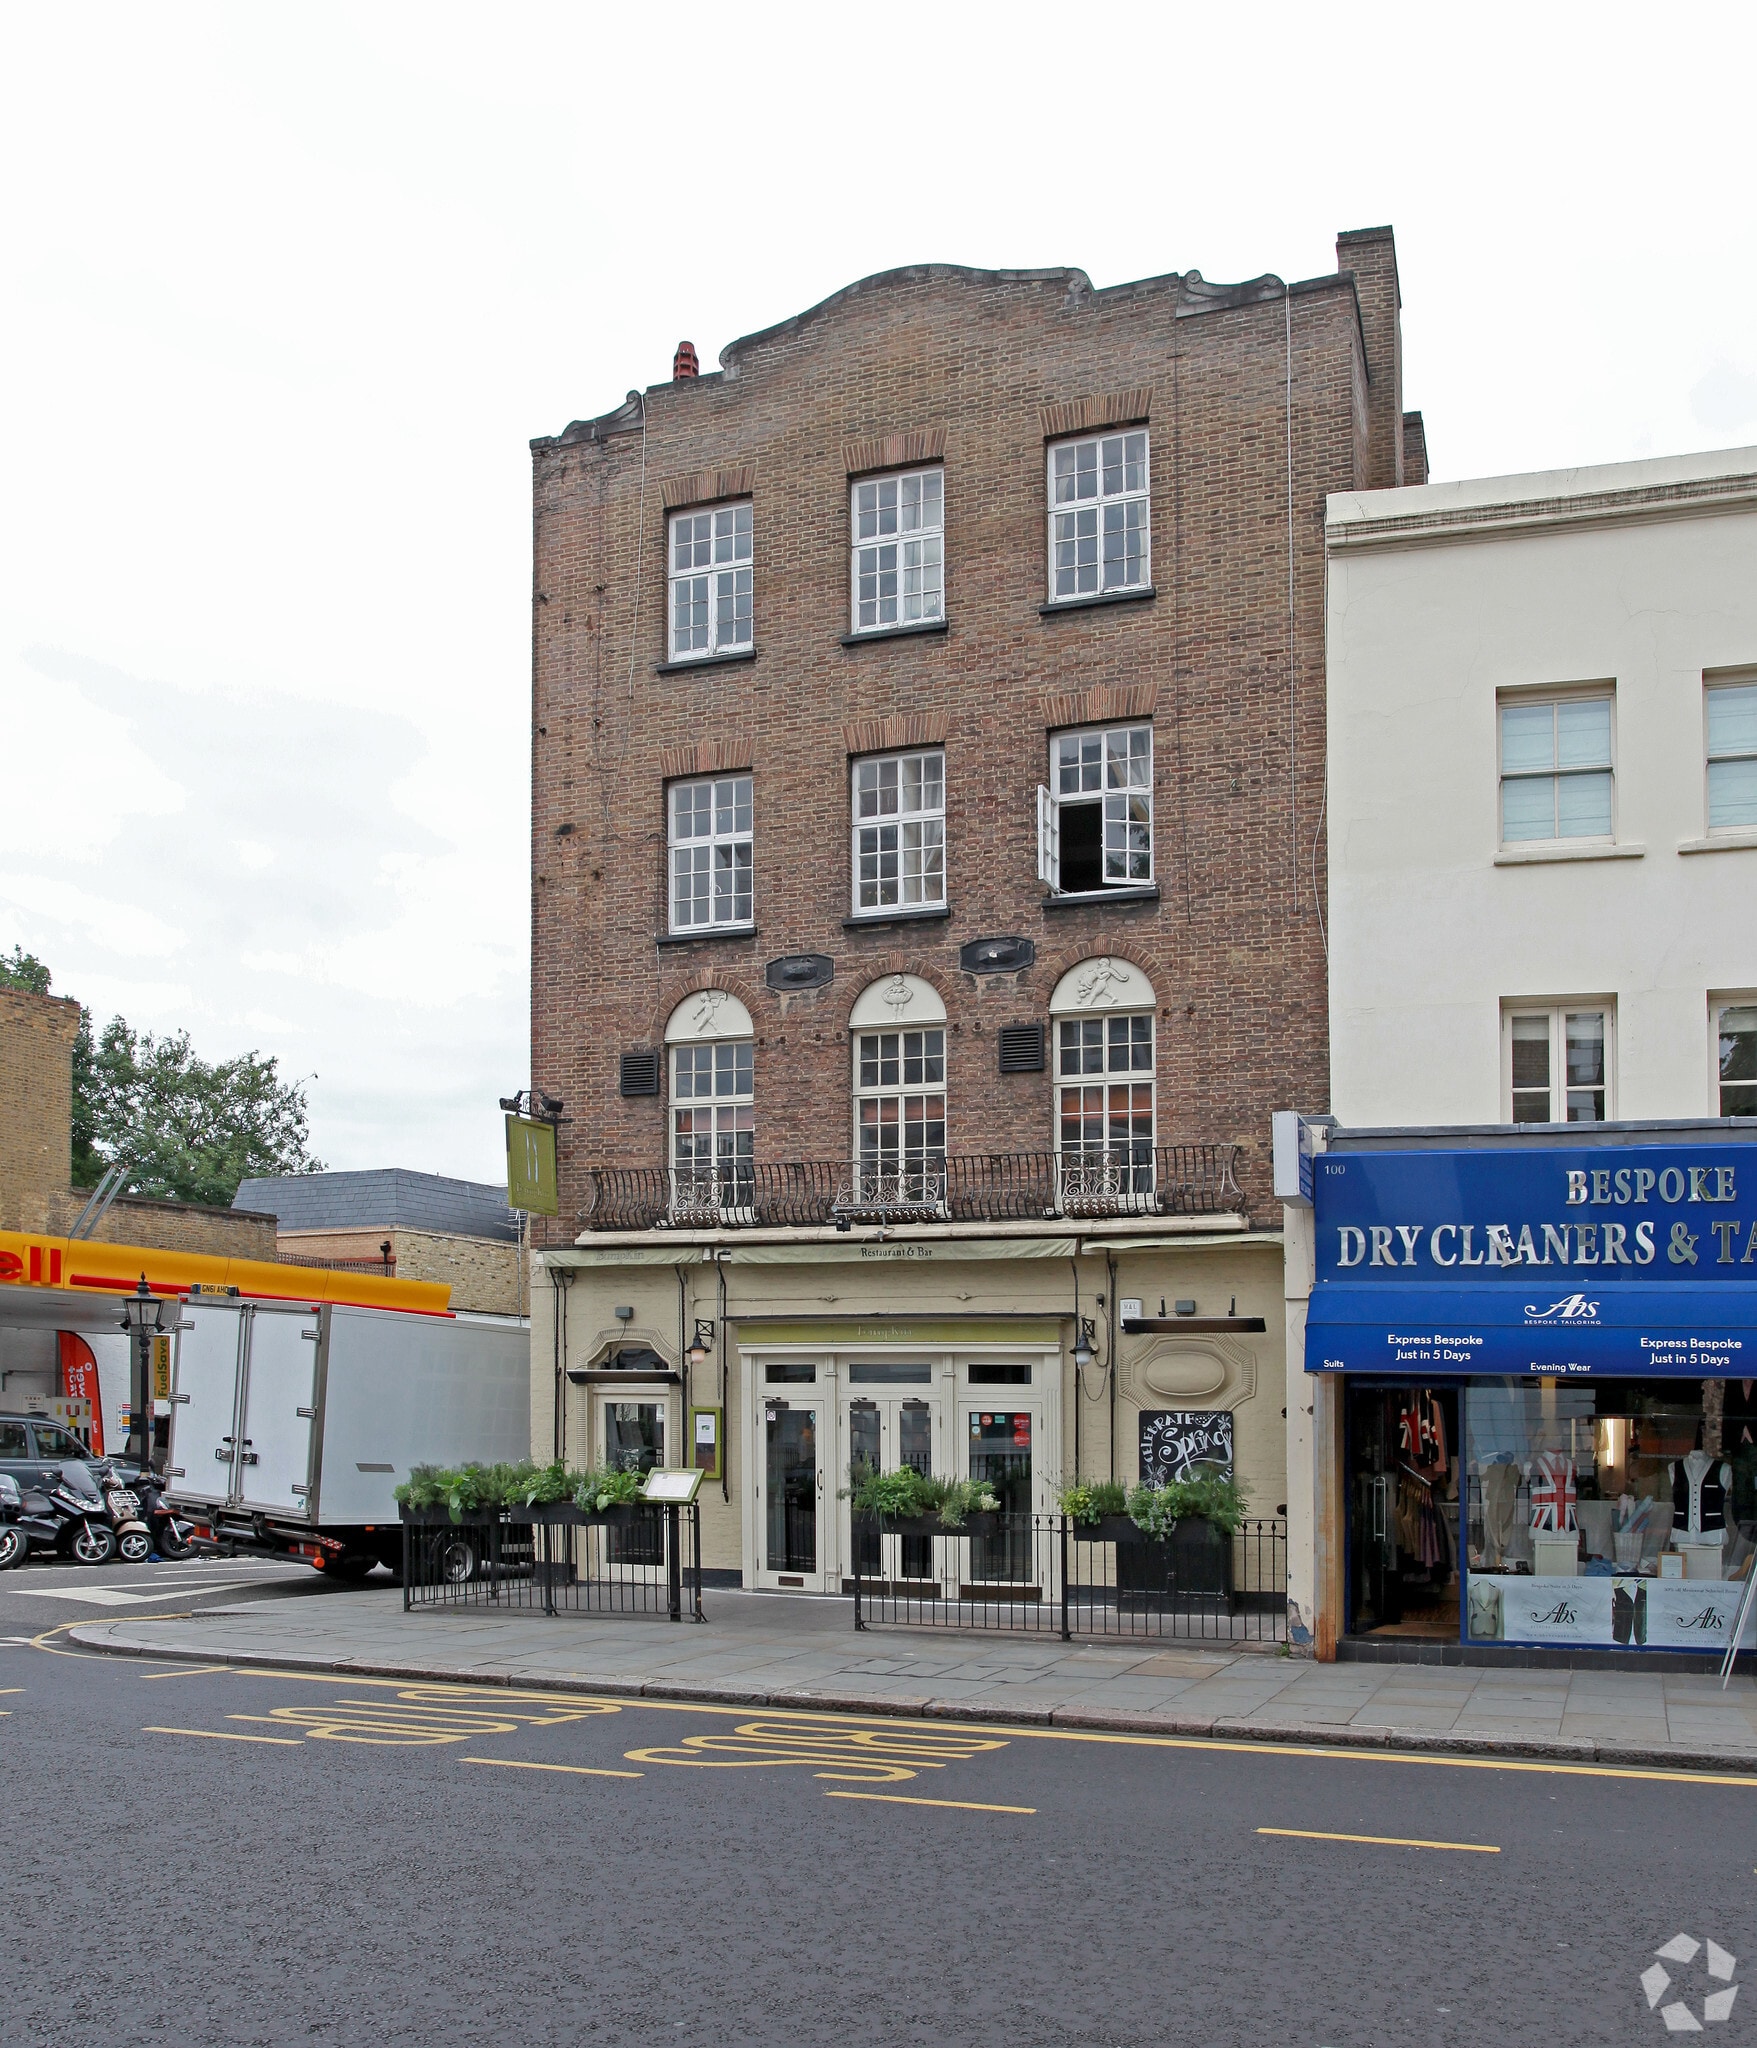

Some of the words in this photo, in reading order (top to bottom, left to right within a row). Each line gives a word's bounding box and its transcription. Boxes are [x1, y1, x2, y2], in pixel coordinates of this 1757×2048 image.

[1324, 1165, 1346, 1175] 100
[1565, 1166, 1738, 1205] BESPOKE
[860, 1247, 905, 1257] Restaurant
[907, 1246, 914, 1257] &
[917, 1246, 933, 1257] Bar
[1336, 1225, 1424, 1267] DRY
[1430, 1221, 1656, 1268] CLEANERS
[1667, 1221, 1699, 1265] &
[1524, 1294, 1600, 1318] Abs
[1387, 1334, 1432, 1346] Express
[1434, 1335, 1484, 1347] Bespoke
[1640, 1337, 1687, 1350] Express
[1690, 1338, 1742, 1351] Bespoke
[1323, 1359, 1344, 1368] Suits
[1396, 1349, 1417, 1361] Just
[1420, 1350, 1430, 1360] in
[1433, 1350, 1441, 1360] 5
[1443, 1350, 1471, 1362] Days
[1649, 1353, 1673, 1365] Just
[1675, 1354, 1687, 1364] in
[1689, 1353, 1698, 1364] 5
[1700, 1353, 1730, 1366] Days
[157, 1338, 167, 1396] FuelSave
[1530, 1362, 1566, 1373] Evening
[1568, 1363, 1591, 1372] Wear
[1141, 1412, 1195, 1463] CELEBRATE
[1159, 1427, 1233, 1484] Spring
[1530, 1601, 1578, 1624] Abs
[1676, 1607, 1725, 1629] Abs
[225, 1689, 623, 1745] STOP
[623, 1722, 1011, 1782] BUS
